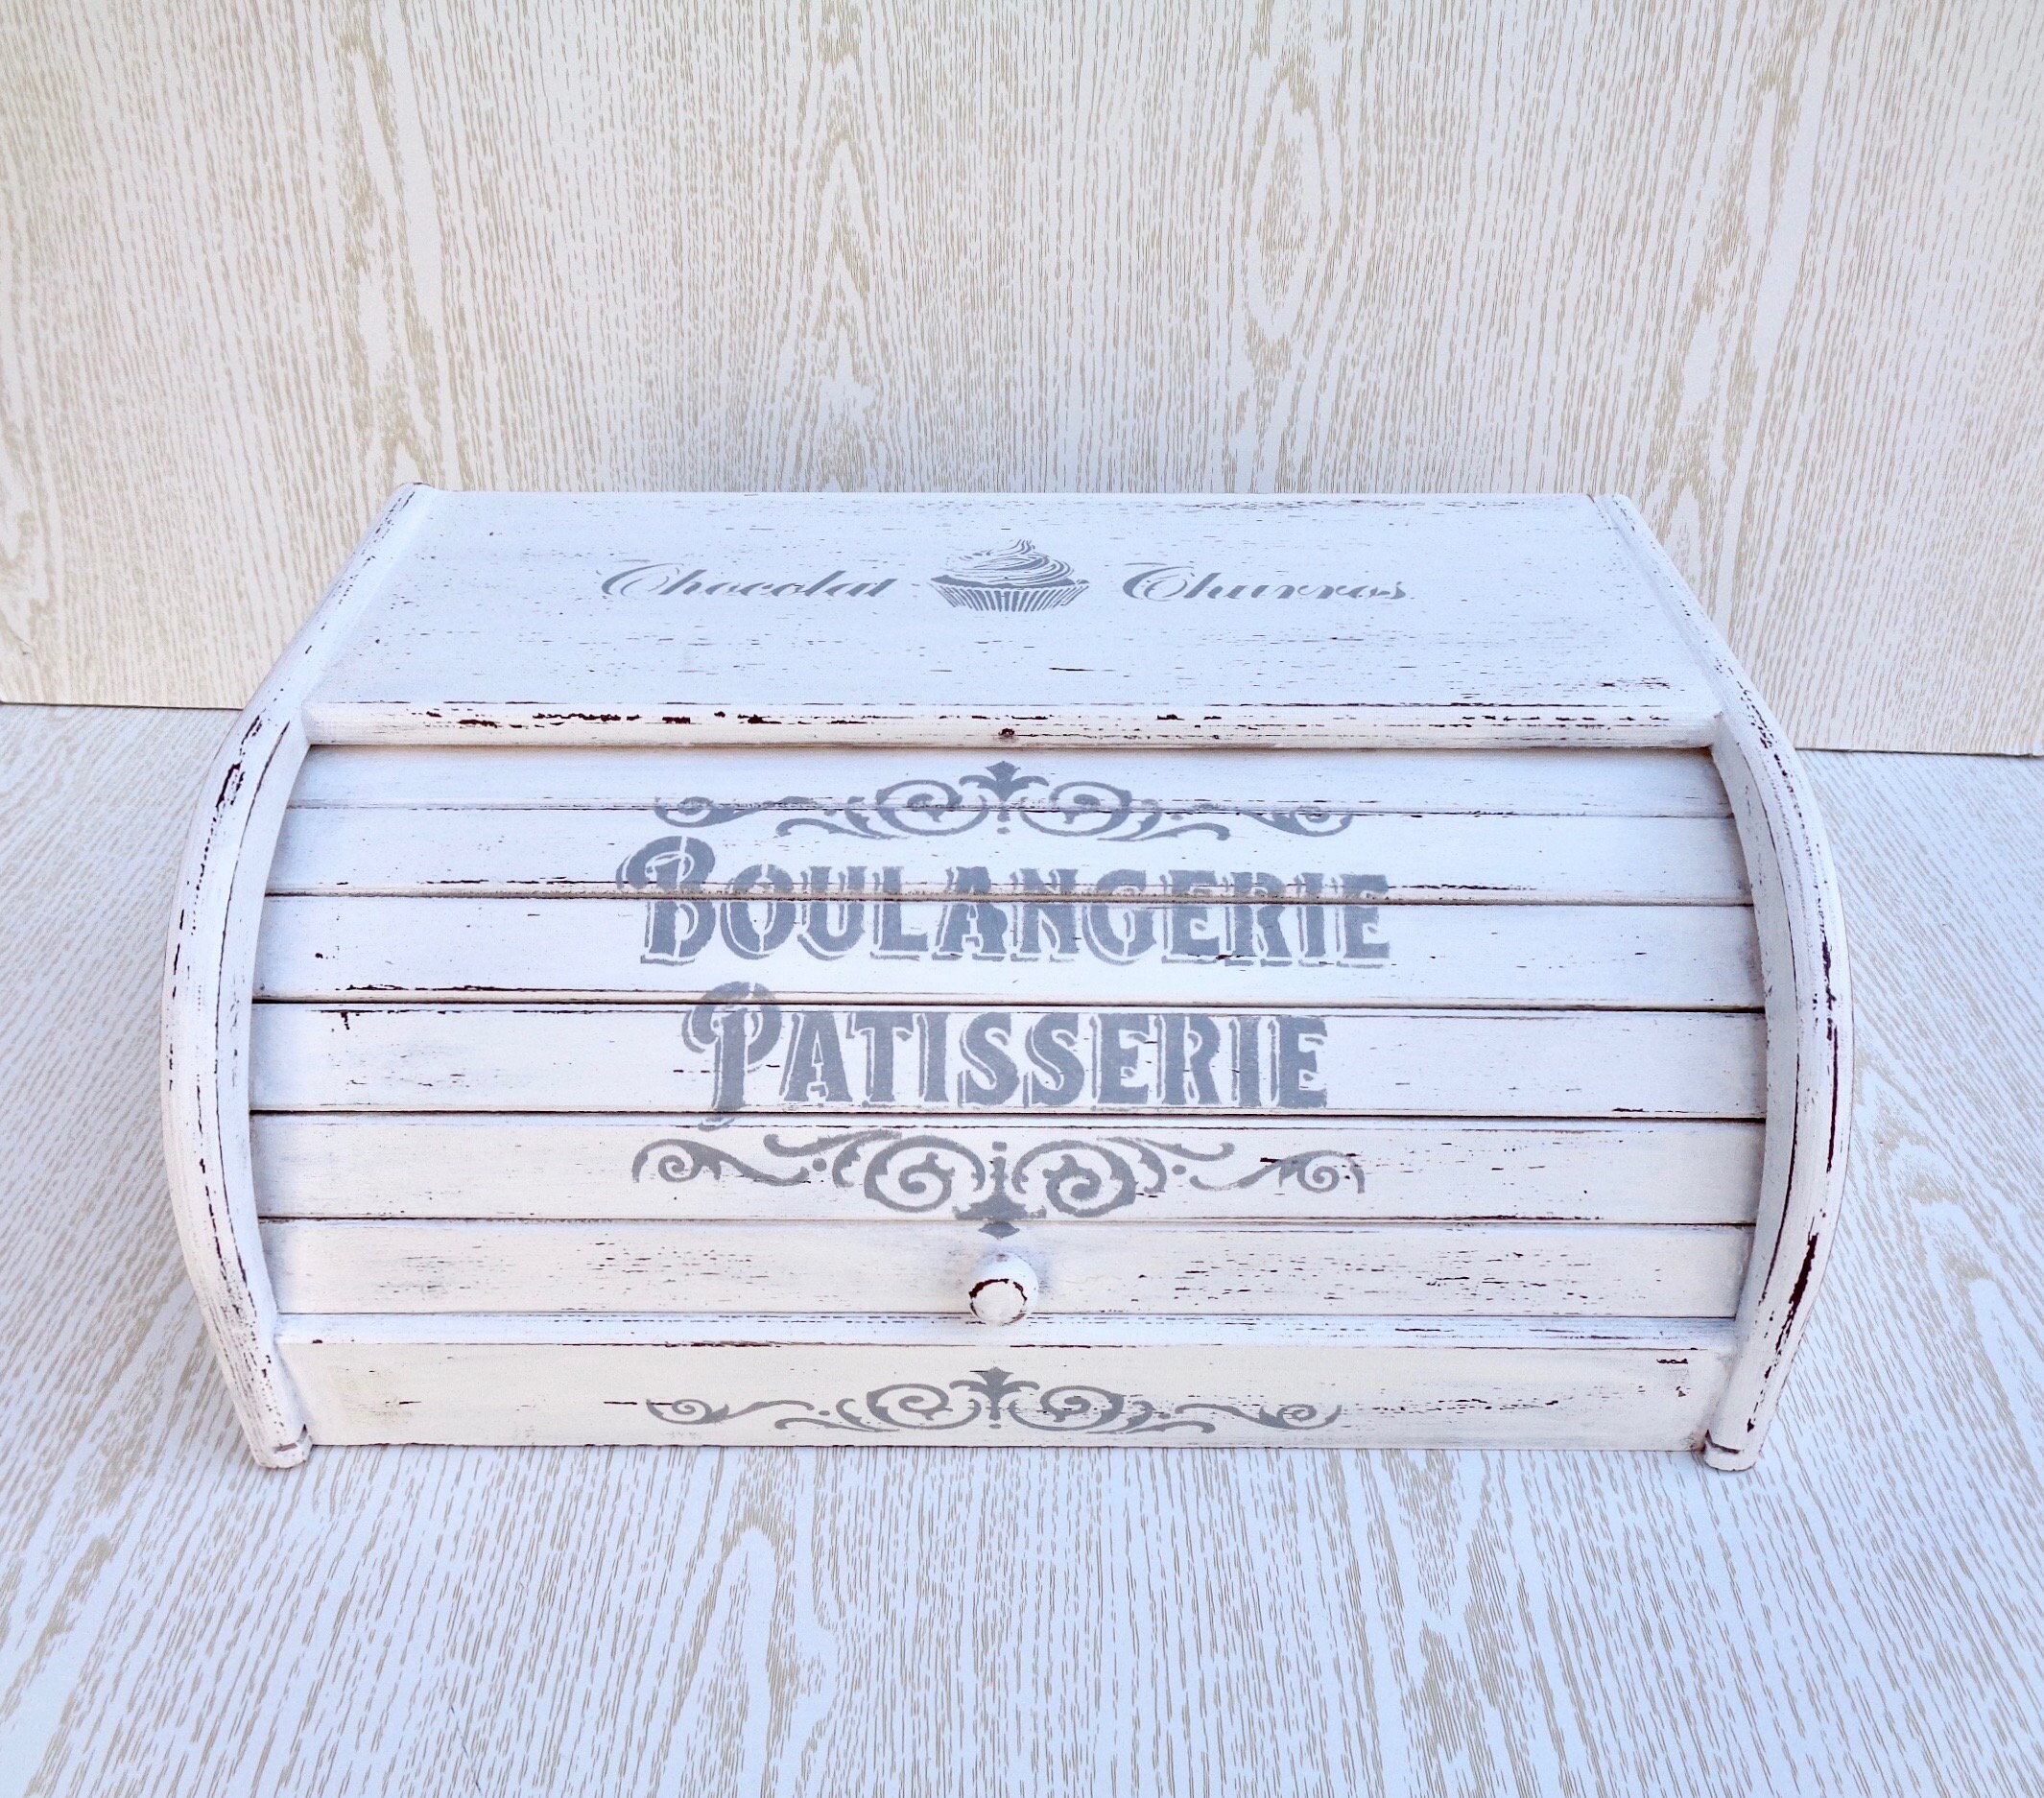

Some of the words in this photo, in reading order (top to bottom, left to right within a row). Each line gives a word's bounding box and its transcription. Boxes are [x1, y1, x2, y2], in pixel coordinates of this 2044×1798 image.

[600, 560, 899, 599] Chocolat
[1121, 561, 1408, 602] Churros
[616, 835, 1391, 969] BOULANGERIE
[682, 982, 1329, 1132] PATISSERIE
